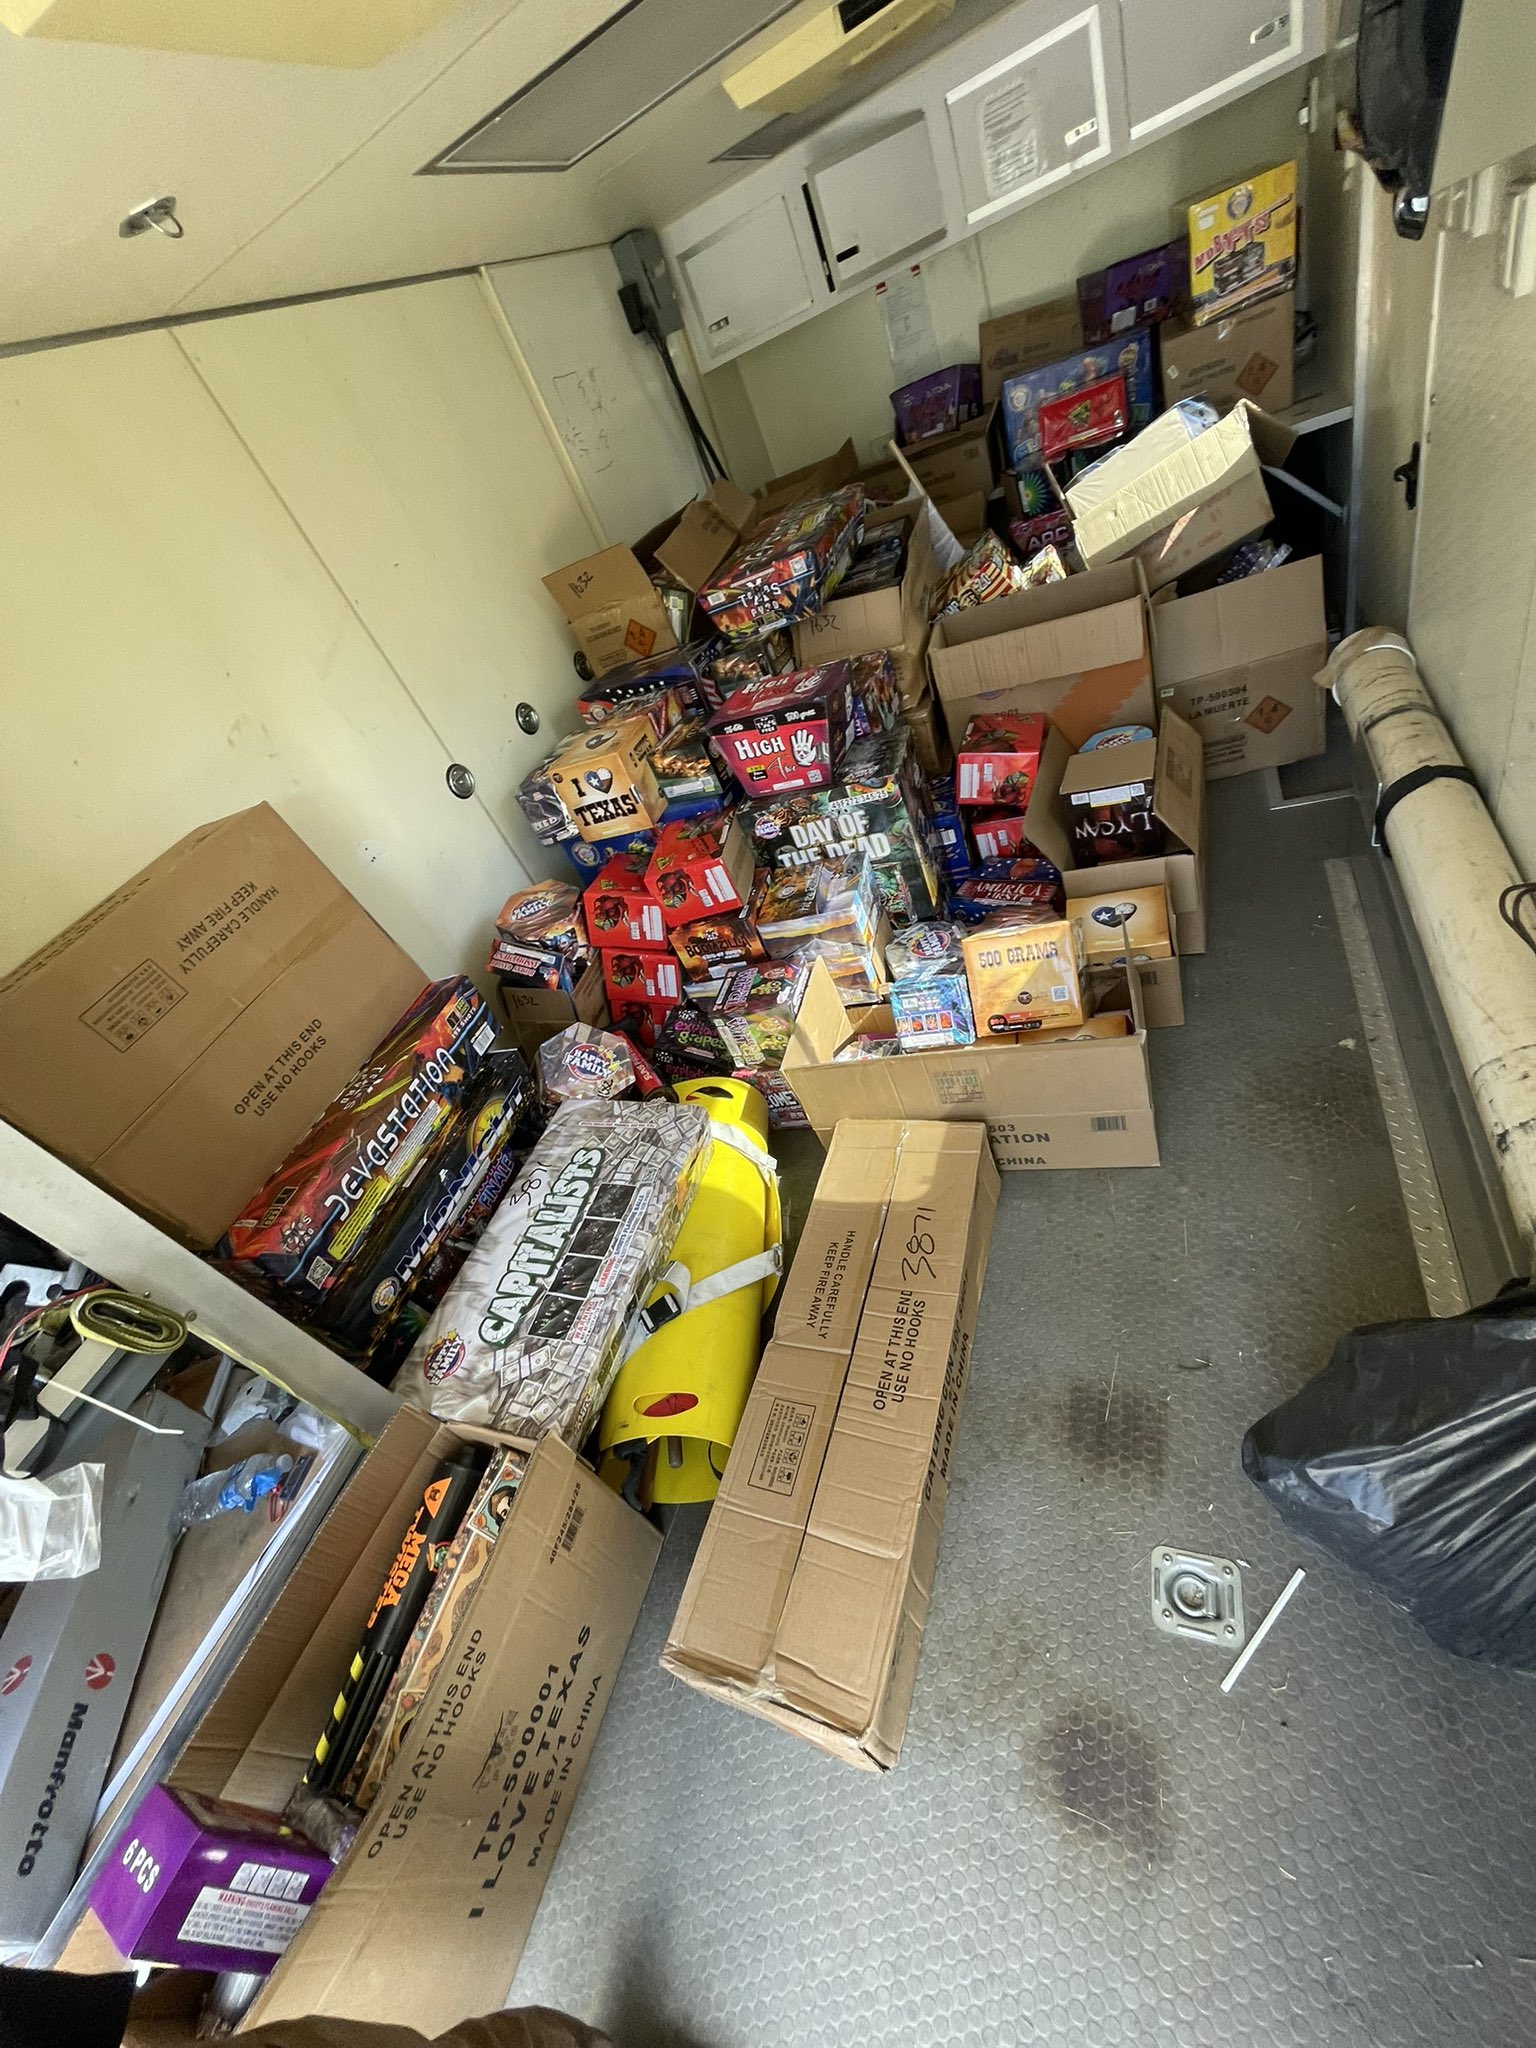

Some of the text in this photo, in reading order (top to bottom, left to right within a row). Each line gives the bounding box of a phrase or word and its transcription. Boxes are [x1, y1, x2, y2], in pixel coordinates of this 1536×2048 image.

[568, 571, 594, 599] 1632
[734, 736, 786, 760] HIGH
[571, 778, 586, 798] I
[574, 794, 639, 826] TEXAS
[778, 832, 892, 868] THE DEAD
[790, 810, 870, 849] DAY OF
[1075, 811, 1152, 839] LYCAN
[176, 881, 258, 952] KEEP FIRE AWAY
[975, 882, 1043, 897] AMERICA
[178, 885, 280, 975] HANDLE CAREFULLY
[684, 936, 752, 958] BOOMZILLA
[978, 941, 1058, 969] 500 GRAMS
[512, 994, 539, 1010] 1632
[234, 1018, 323, 1115] OPEN AT THIS END
[565, 1054, 612, 1078] FAMILY
[574, 1050, 610, 1069] HAPPY
[678, 1031, 726, 1050] grapes
[254, 1035, 328, 1117] USE NO HOOKS
[324, 1047, 457, 1222] DEVASTATION
[990, 1132, 1050, 1145] ATION
[996, 1156, 1047, 1167] CHINA
[394, 1075, 524, 1283] MIDNIGHT
[479, 1156, 514, 1211] FINALE
[479, 1148, 605, 1345] CAPITALISTS
[806, 1242, 840, 1329] KEEP FIRE AWAY
[818, 1230, 856, 1340] HANDLE CAREFULLY
[574, 1300, 595, 1340] WARNING
[427, 1340, 452, 1379] HAPPY
[430, 1336, 464, 1387] FAMILY
[873, 1290, 914, 1410] OPEN AT THIS END
[892, 1299, 927, 1403] USE NO HOOKS
[940, 1332, 971, 1478] MADE IN CHINA
[923, 1401, 947, 1503] GATLING
[382, 1532, 427, 1608] MEGA
[367, 1629, 484, 1859] OPEN AT THIS END
[393, 1651, 488, 1840] USE NO HOOKS
[472, 1663, 560, 1861] TP-500001
[482, 1771, 542, 1889] LOVE
[536, 1624, 592, 1758] TEXAS
[527, 1675, 602, 1868] MADE IN CHINA
[16, 1701, 90, 1878] Manfrotto
[121, 1838, 161, 1895] 6 PCS
